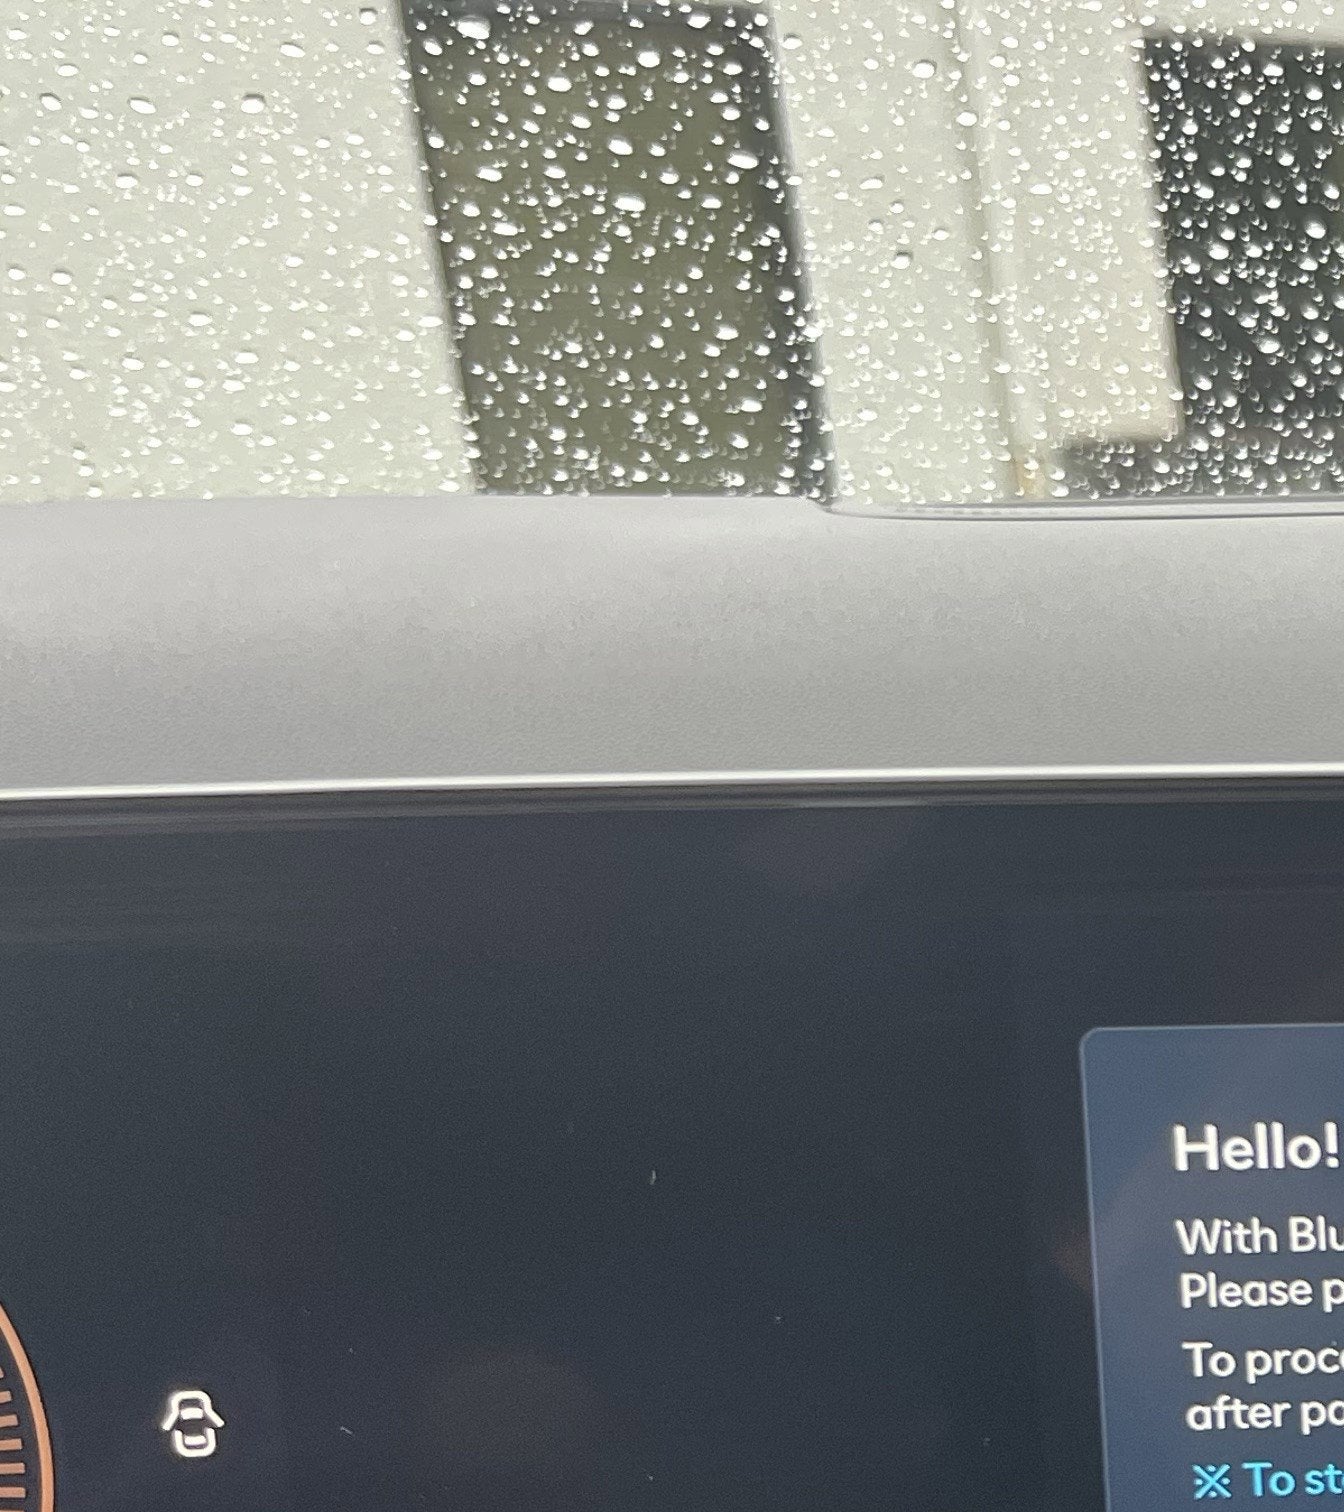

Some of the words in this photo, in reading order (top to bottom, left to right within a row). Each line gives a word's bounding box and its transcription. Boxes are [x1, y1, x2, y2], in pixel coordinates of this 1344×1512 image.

[1172, 1120, 1340, 1173] Hello!
[1174, 1213, 1279, 1257] With
[1179, 1270, 1314, 1310] Please
[1180, 1340, 1237, 1379] To
[1184, 1393, 1293, 1432] after
[1240, 1460, 1297, 1498] To
